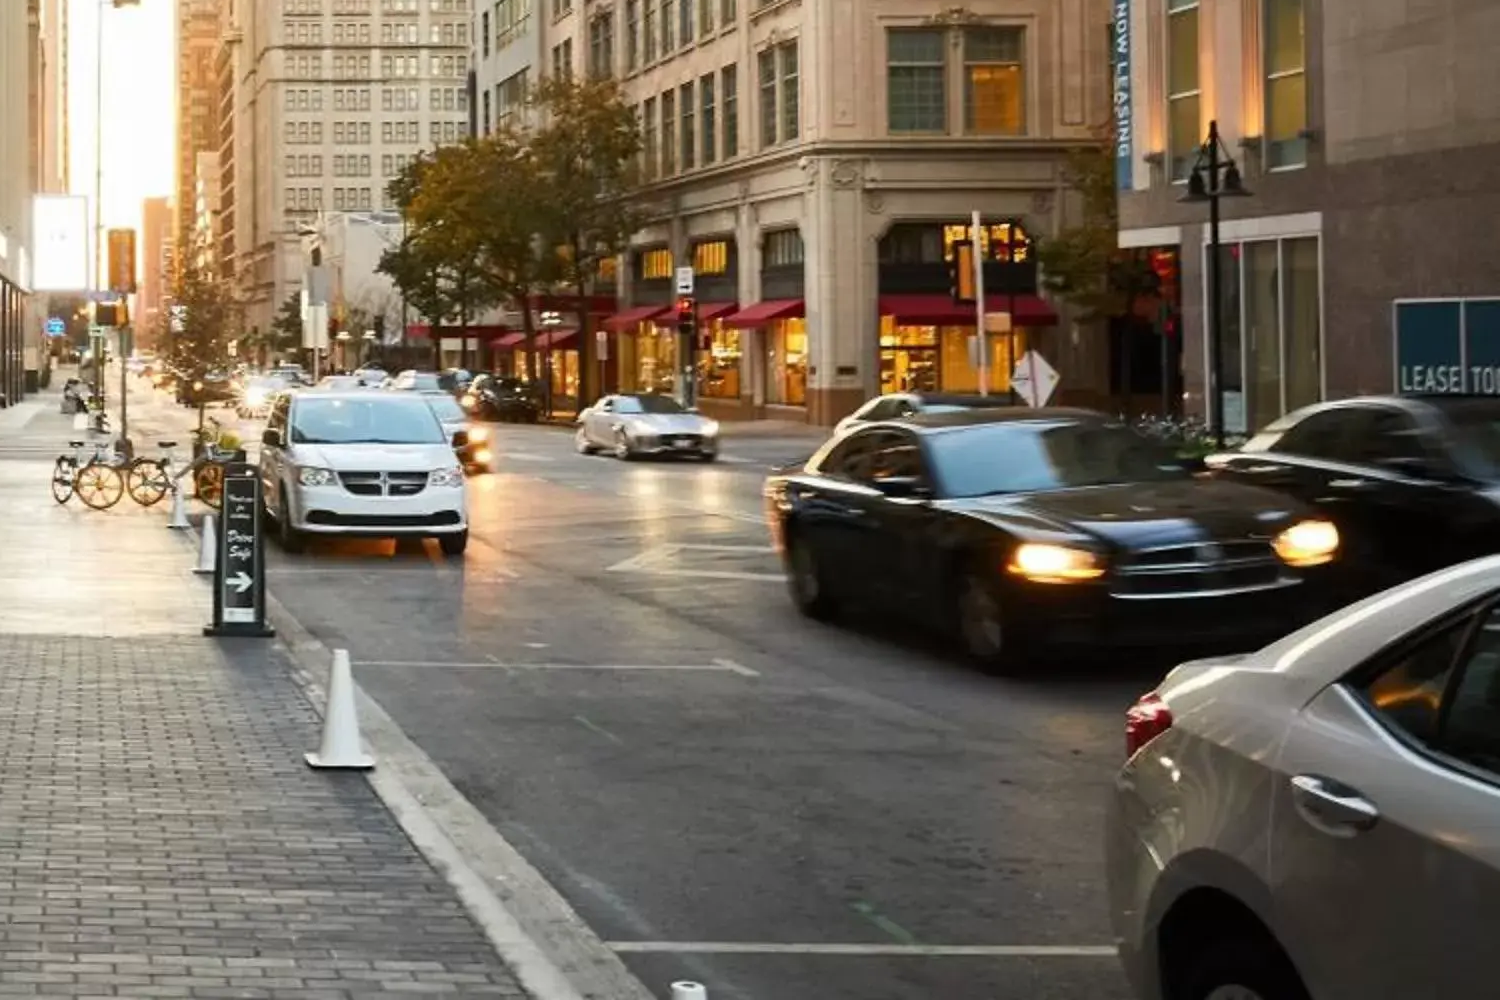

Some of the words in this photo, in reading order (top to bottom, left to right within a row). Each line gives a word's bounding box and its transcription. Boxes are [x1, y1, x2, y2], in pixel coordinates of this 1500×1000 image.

[1114, 2, 1129, 52] NOW
[1114, 63, 1130, 157] LEASING
[1401, 365, 1460, 393] LEASE
[1470, 366, 1500, 395] TO
